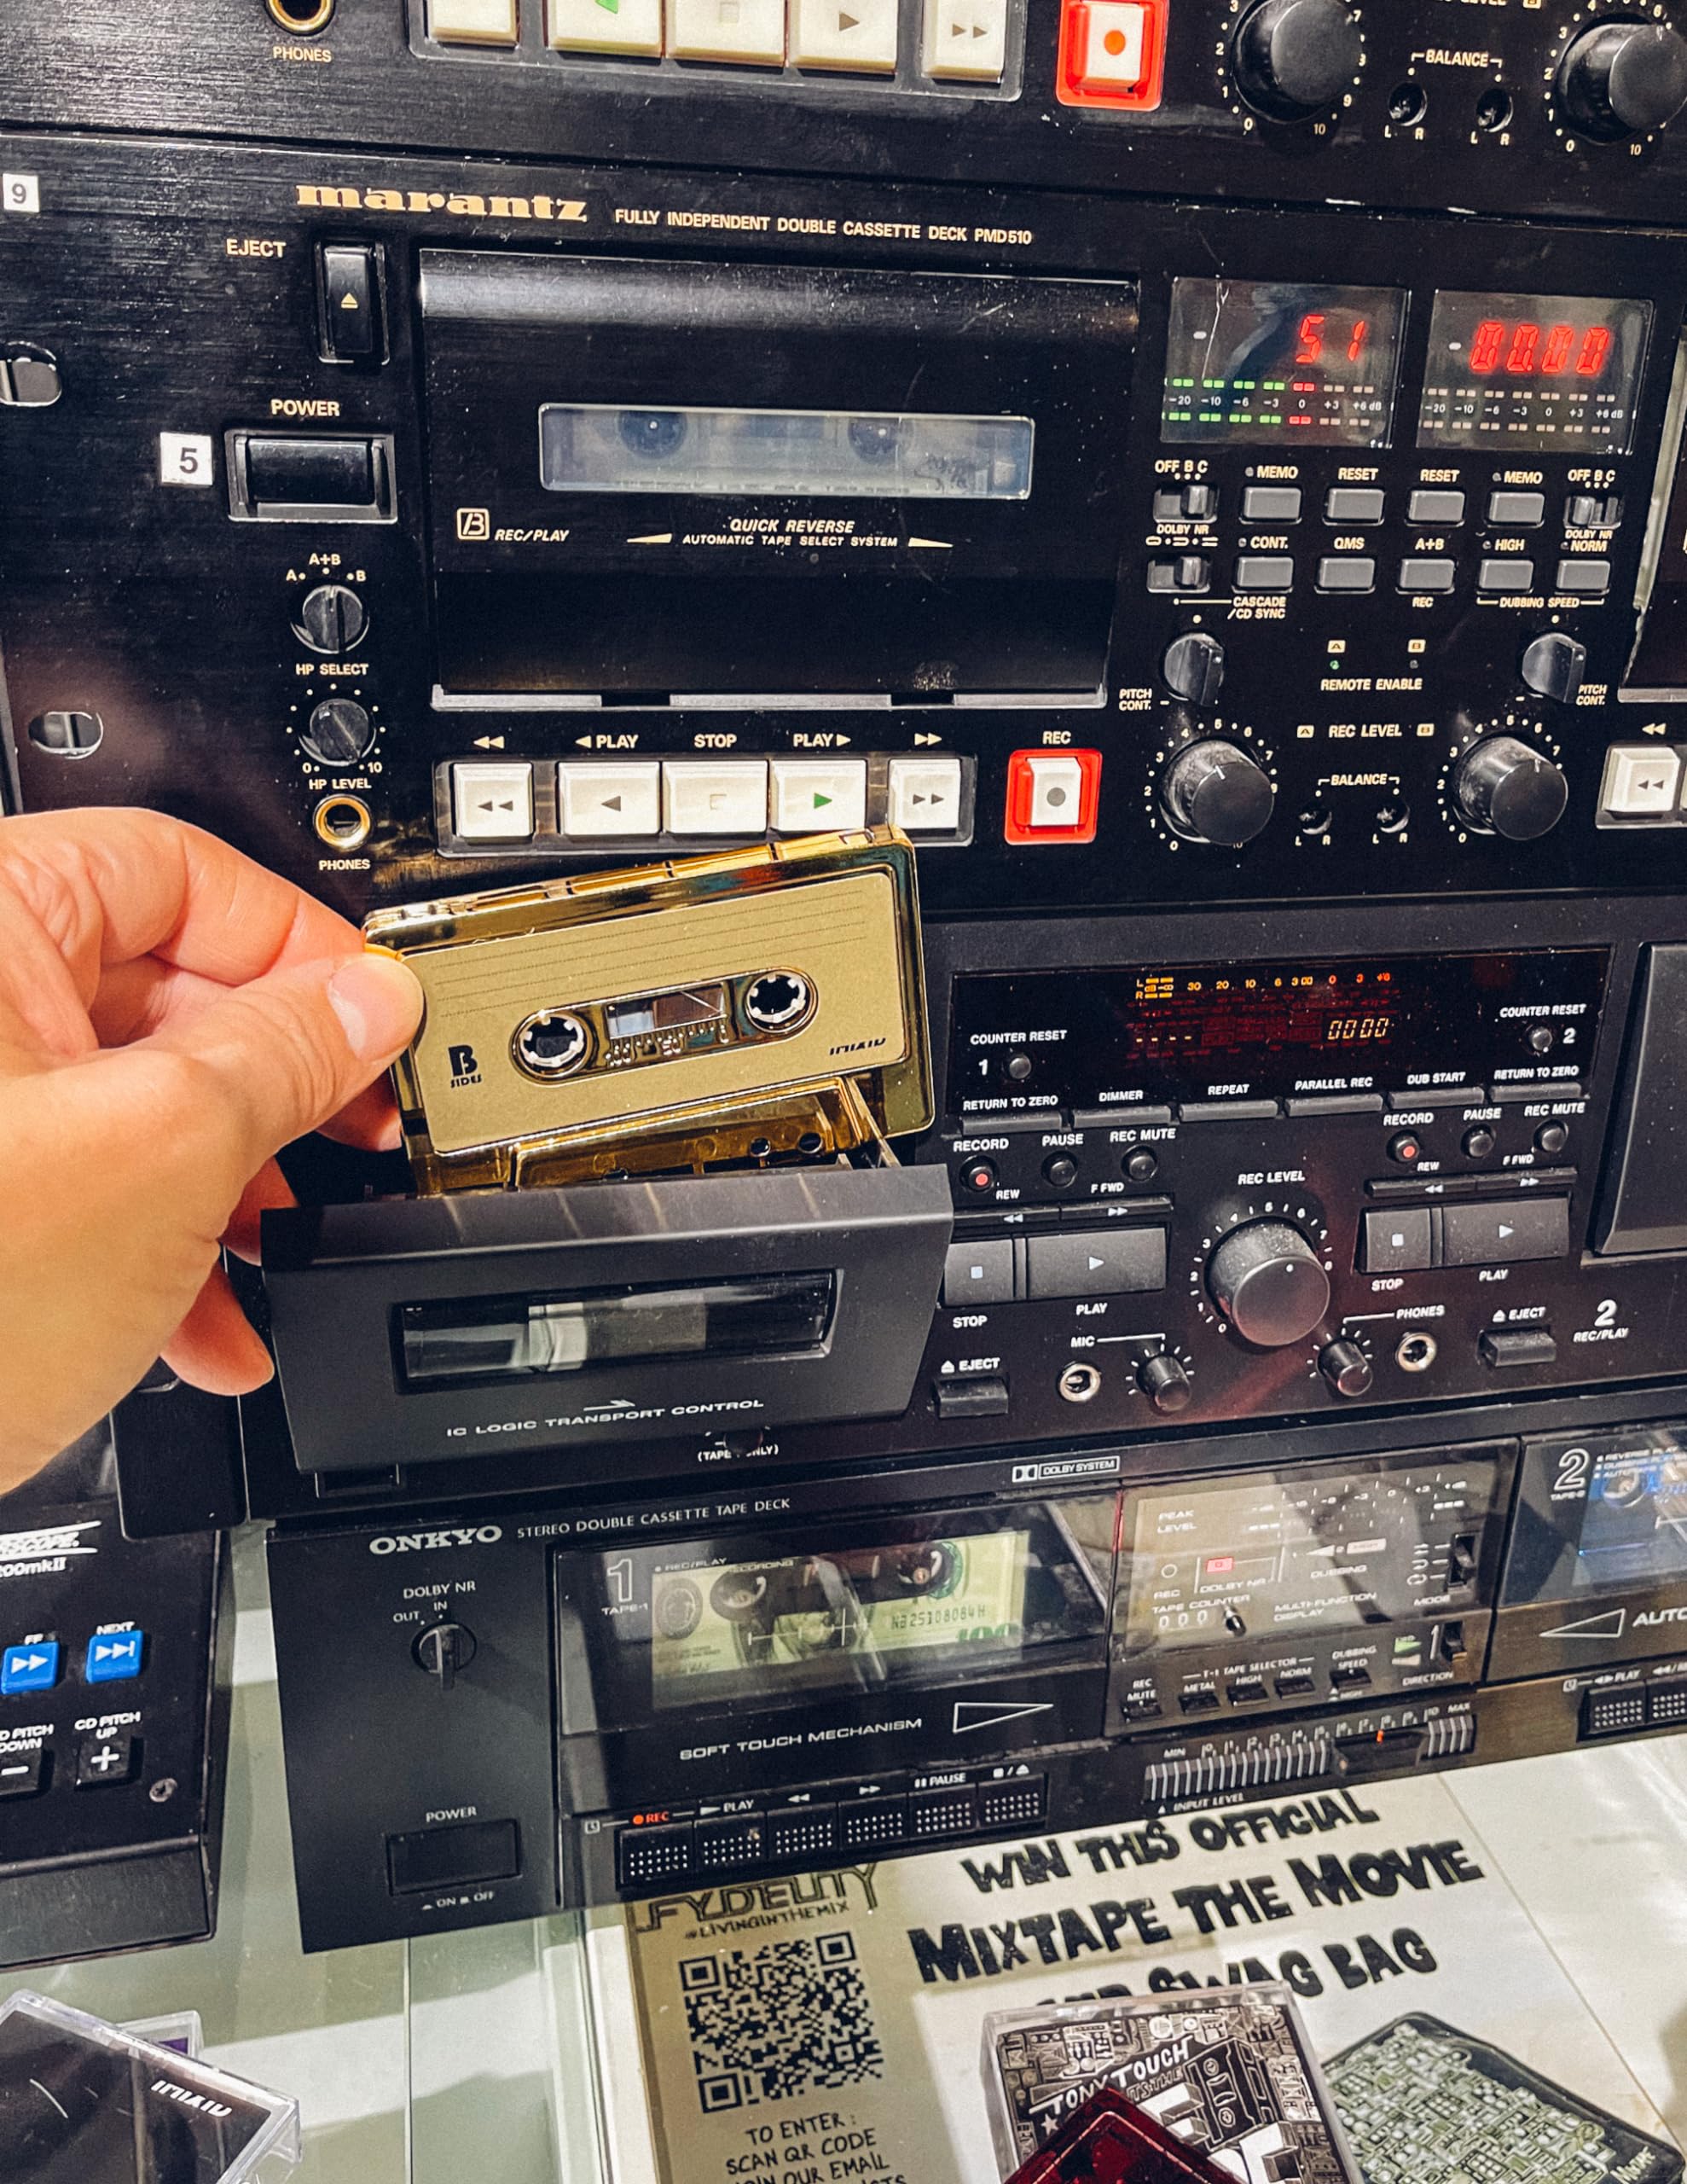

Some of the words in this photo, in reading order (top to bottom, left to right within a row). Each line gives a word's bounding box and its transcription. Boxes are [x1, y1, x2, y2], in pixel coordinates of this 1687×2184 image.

[273, 46, 332, 63] PHONES
[1426, 49, 1489, 67] BALANCE
[11, 183, 27, 203] 9
[296, 184, 588, 223] marantz
[615, 208, 659, 225] FULLY
[667, 211, 769, 231] INDEPENDENT
[777, 218, 836, 235] DOUBLE
[843, 221, 920, 239] CASSETTE
[929, 225, 967, 241] DECK
[974, 228, 1033, 245] PMD510
[226, 239, 286, 258] EJECT
[270, 399, 340, 417] POWER
[179, 448, 198, 473] 5
[1257, 466, 1298, 479] MEMO
[1338, 468, 1377, 480] RESET
[1420, 469, 1459, 482] RESET
[1504, 470, 1542, 484] MEMO
[730, 520, 780, 533] QUICK
[786, 520, 855, 533] REVERSE
[1157, 524, 1190, 535] DOLBY
[1195, 524, 1209, 536] NR
[495, 529, 569, 542] REC/PLAY
[683, 536, 756, 546] AUTOMATIC
[762, 536, 791, 546] TAPE
[799, 536, 844, 547] SELECT
[850, 537, 898, 547] SYSTEM
[1334, 537, 1364, 550] QMS
[1495, 538, 1524, 551] HIGH
[1571, 539, 1607, 552] NORM
[1413, 597, 1433, 607] REC
[1500, 597, 1544, 608] DUBBING
[1548, 597, 1580, 608] SPEED
[296, 665, 315, 675] HP
[320, 664, 368, 675] SELECT
[1321, 679, 1371, 691] REMOTE
[1377, 678, 1422, 691] ENABLE
[1043, 731, 1071, 744] REC
[1329, 725, 1354, 737] REC
[1361, 724, 1401, 737] LEVEL
[596, 735, 639, 748] PLAY
[694, 735, 737, 747] STOP
[793, 734, 832, 747] PLAY
[310, 779, 327, 789] HP
[333, 778, 371, 789] LEVEL
[1330, 773, 1387, 787] BALANCE
[319, 859, 370, 870] PHONES
[1499, 1006, 1550, 1018] COUNTER
[1551, 1003, 1586, 1015] RESET
[971, 1032, 1026, 1045] COUNTER
[1029, 1030, 1067, 1042] RESET
[449, 1044, 478, 1077] B
[1407, 1073, 1429, 1084] DUB
[1432, 1072, 1465, 1083] START
[1493, 1068, 1533, 1079] RETURN
[1536, 1067, 1550, 1077] TO
[1551, 1066, 1579, 1076] ZERO
[449, 1074, 483, 1089] SIDES
[1295, 1078, 1348, 1091] PARALLEL
[1350, 1077, 1372, 1088] REC
[1099, 1090, 1143, 1101] DIMMER
[1208, 1084, 1249, 1095] REPEAT
[963, 1098, 1008, 1111] RETURN
[1011, 1097, 1025, 1107] TO
[1028, 1095, 1058, 1107] ZERO
[1524, 1105, 1549, 1117] REC
[1551, 1102, 1586, 1115] MUTE
[1383, 1112, 1434, 1126] RECORD
[1463, 1107, 1501, 1120] PAUSE
[1041, 1133, 1084, 1147] PAUSE
[1110, 1130, 1138, 1143] REC
[1140, 1128, 1176, 1141] MUTE
[954, 1138, 1009, 1152] RECORD
[1512, 1154, 1533, 1165] FWD
[1238, 1172, 1264, 1185] REC
[1267, 1170, 1305, 1182] LEVEL
[996, 1189, 1020, 1199] REW
[1100, 1182, 1124, 1193] FWD
[1479, 1269, 1508, 1281] PLAY
[1371, 1278, 1404, 1292] STOP
[1076, 1303, 1107, 1315] PLAY
[1396, 1305, 1445, 1319] PHONES
[1508, 1307, 1546, 1321] EJECT
[1594, 1299, 1617, 1327] 2
[953, 1316, 988, 1328] STOP
[1071, 1335, 1095, 1347] MIC
[1573, 1327, 1628, 1342] REC/PLAY
[959, 1357, 1000, 1371] EJECT
[446, 1426, 467, 1438] IC
[475, 1420, 537, 1435] LOGIC
[545, 1409, 665, 1427] TRANSPORT
[671, 1400, 764, 1415] CONTROL
[1043, 1464, 1075, 1475] DOLBY
[1075, 1460, 1115, 1472] SYSTEM
[1554, 1448, 1590, 1490] 2
[517, 1523, 571, 1539] STEREO
[576, 1515, 635, 1532] DOUBLE
[641, 1507, 710, 1525] CASSETTE
[715, 1503, 747, 1516] TAPE
[754, 1498, 791, 1511] DECK
[1159, 1510, 1193, 1520] PEAK
[1157, 1522, 1197, 1533] LEVEL
[369, 1525, 502, 1555] ONKYO
[607, 1559, 632, 1602] 1
[403, 1583, 450, 1600] DOLBY
[455, 1581, 476, 1593] NR
[433, 1600, 447, 1611] IN
[1152, 1603, 1184, 1614] TAPE
[1189, 1594, 1250, 1609] COUNTER
[393, 1611, 420, 1623] OUT
[96, 1621, 135, 1635] NEXT
[1223, 1664, 1246, 1676] TAPE
[1249, 1658, 1296, 1672] SELECTOR
[1338, 1659, 1367, 1669] SPEED
[1402, 1672, 1452, 1686] DIRECTION
[1127, 1690, 1156, 1700] MUTE
[74, 1718, 97, 1730] CD
[99, 1711, 141, 1728] PITCH
[96, 1727, 118, 1740] UP
[680, 1744, 728, 1761] SOFT
[737, 1734, 802, 1752] TOUCH
[808, 1717, 923, 1744] MECHANISM
[929, 1772, 965, 1786] PAUSE
[1174, 1799, 1208, 1810] INPUT
[1214, 1792, 1243, 1804] LEVEL
[426, 1806, 477, 1821] POWER
[646, 1811, 670, 1822] REC
[960, 1839, 1070, 1893] WIN
[1078, 1820, 1180, 1874] THIS
[1194, 1789, 1380, 1851] OFFICIAL
[907, 1897, 1169, 1984] MIXTAPE
[1173, 1876, 1294, 1934] THE
[1287, 1838, 1486, 1908] MOVIE
[1323, 1927, 1438, 1989] BAG
[1029, 2076, 1107, 2115] TONY
[1111, 2035, 1193, 2088] TOUCH
[745, 2126, 773, 2146] TO
[726, 2149, 778, 2175] SCAN
[784, 2144, 814, 2163] QR
[821, 2128, 877, 2156] CODE
[829, 2152, 890, 2181] EMAIL
